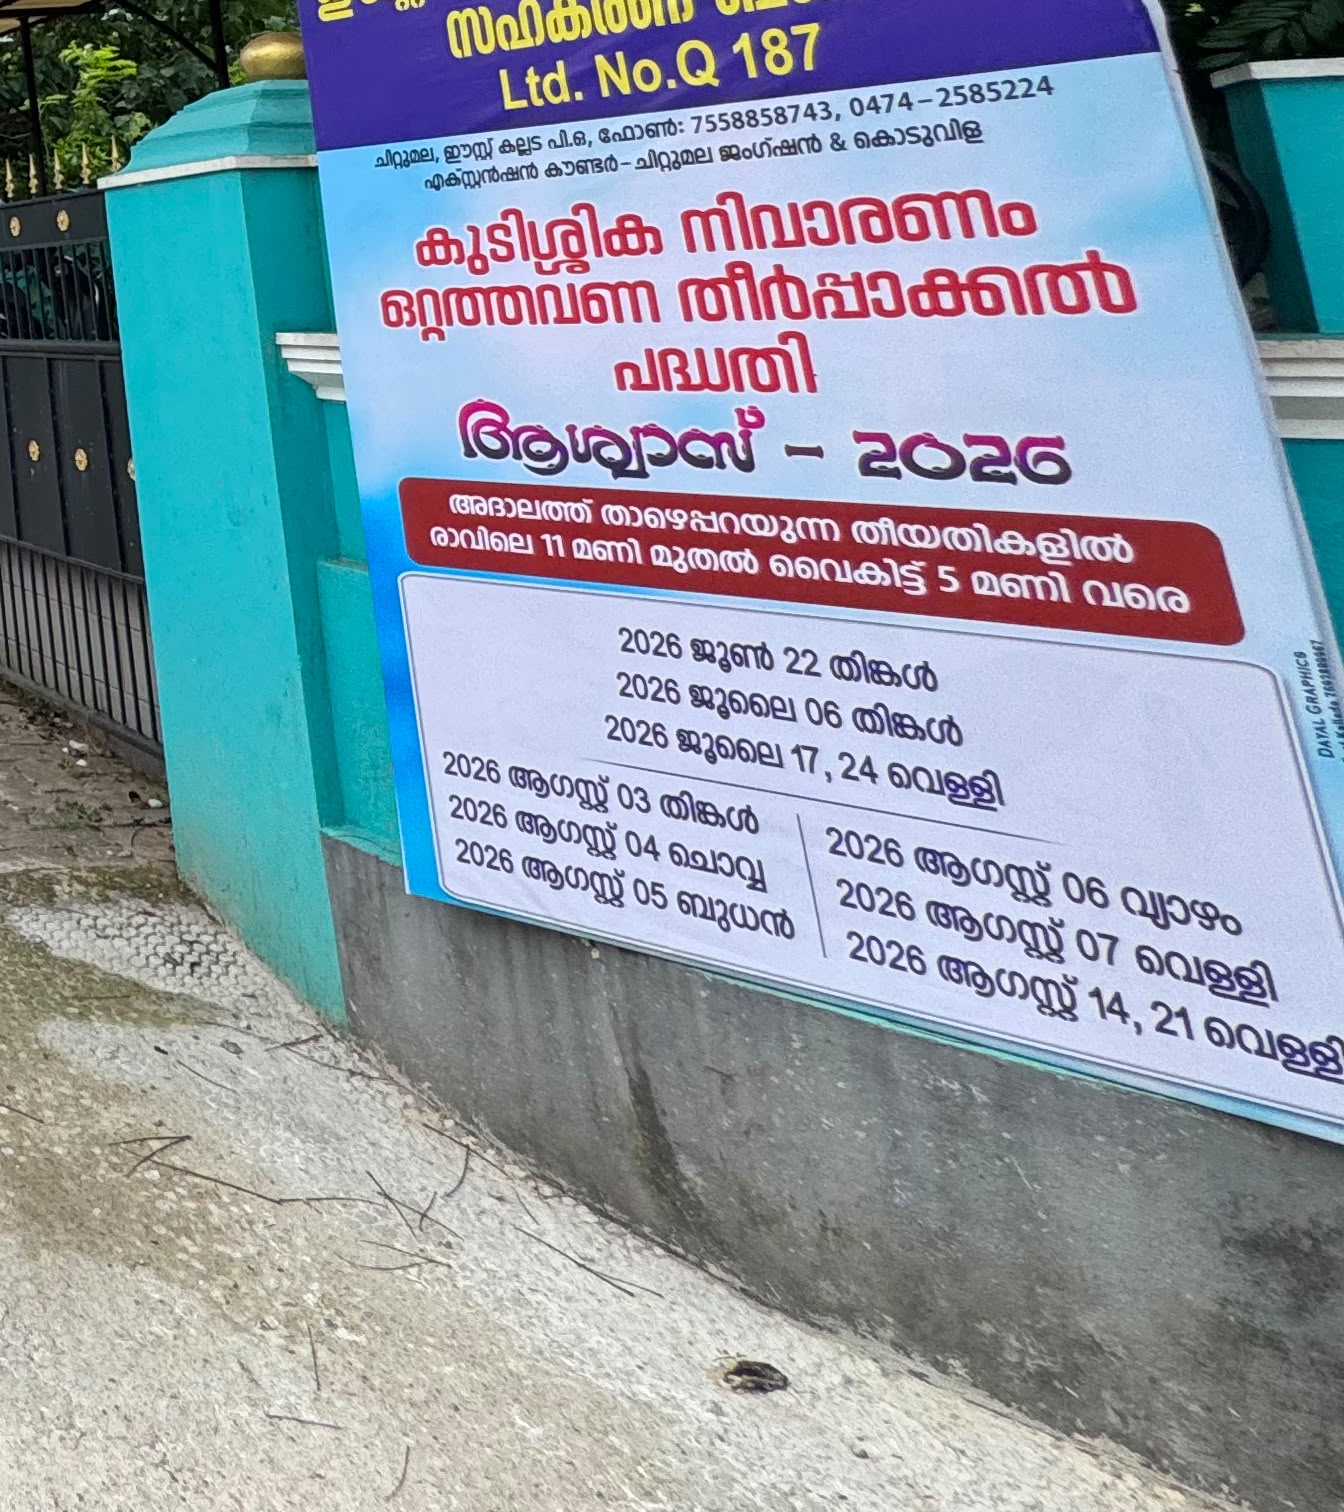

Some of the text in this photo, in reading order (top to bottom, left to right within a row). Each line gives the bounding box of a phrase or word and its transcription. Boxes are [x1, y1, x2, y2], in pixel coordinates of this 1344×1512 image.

[499, 60, 583, 110] Ltd.
[732, 22, 821, 78] 187
[444, 137, 493, 164] ഈസ്റ്റ്
[498, 134, 543, 158] കല്ലട
[691, 99, 842, 135] 7558858743,
[830, 133, 848, 153] &
[854, 118, 985, 149] കൊടുവിള
[681, 189, 1038, 254] നിവാരണം
[380, 249, 1138, 341] ഒറ്റത്തവണ തീർപ്പാക്കൽ
[614, 330, 818, 393] പദ്ധതി
[458, 399, 766, 480] ആശ്വാസ്
[852, 430, 1072, 485] 2026
[429, 524, 1191, 614] രാവിലെ 11 മണി മുതൽ വൈകിട്ട് 5 മണി വരെ
[448, 493, 1135, 566] അദാലത്ത് താഴെപ്പറയുന്ന തീയതികളിൽ
[618, 627, 939, 693] 2026 ജൂൺ 22 തിങ്കൾ
[616, 671, 964, 747] 2026 ജൂലൈ 06 തിങ്കൾ
[442, 751, 501, 784] 2026
[616, 782, 652, 814] 03
[660, 790, 761, 835] തിങ്കൾ
[604, 715, 669, 749] 2026
[676, 727, 784, 769] ജൂലൈ
[838, 751, 879, 785] 24
[887, 762, 1006, 812] വെള്ളി
[448, 794, 508, 829] 2026
[625, 830, 660, 862] 04
[455, 838, 514, 874] 2026
[632, 877, 669, 910] 05
[676, 890, 796, 940] ബുധൻ
[825, 826, 905, 868] 2026
[1062, 871, 1109, 910] 06
[1120, 885, 1244, 937] വ്യാഴം
[836, 878, 915, 922] 2026
[1075, 927, 1121, 967] 07
[1134, 944, 1281, 1009] വെള്ളി
[846, 931, 927, 976] 2026
[1150, 1000, 1195, 1041] 21
